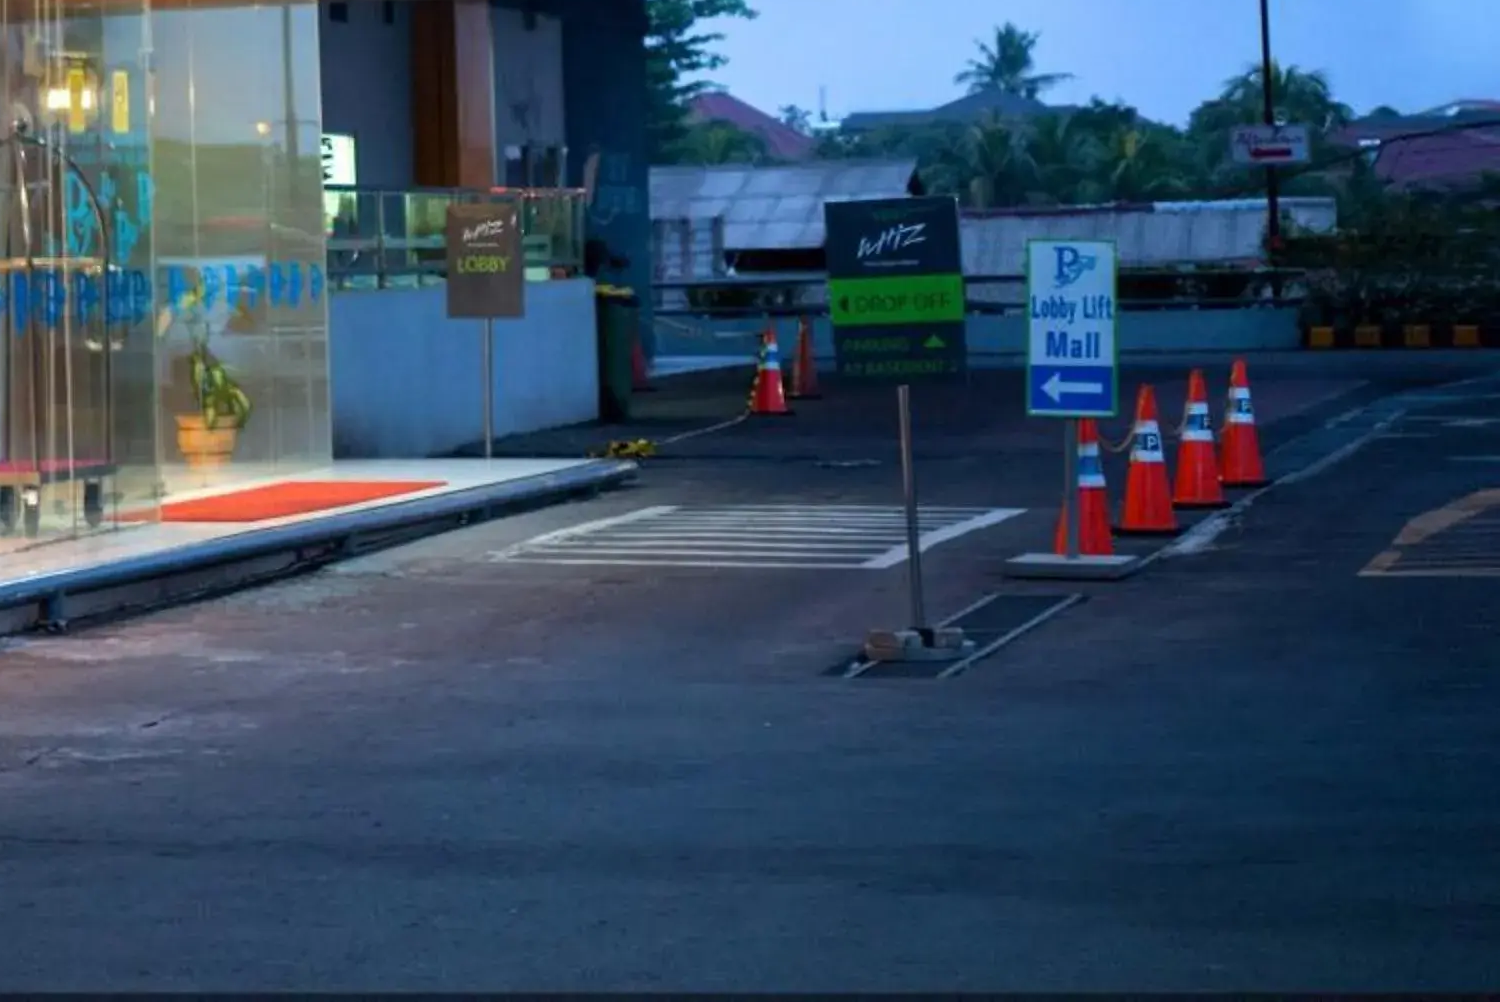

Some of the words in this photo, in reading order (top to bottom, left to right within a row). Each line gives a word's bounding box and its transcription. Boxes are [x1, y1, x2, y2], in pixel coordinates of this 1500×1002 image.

[456, 255, 511, 274] LOBBY
[1032, 294, 1077, 324] Lobby
[1083, 294, 1113, 319] Lift
[1046, 330, 1100, 359] Mall
